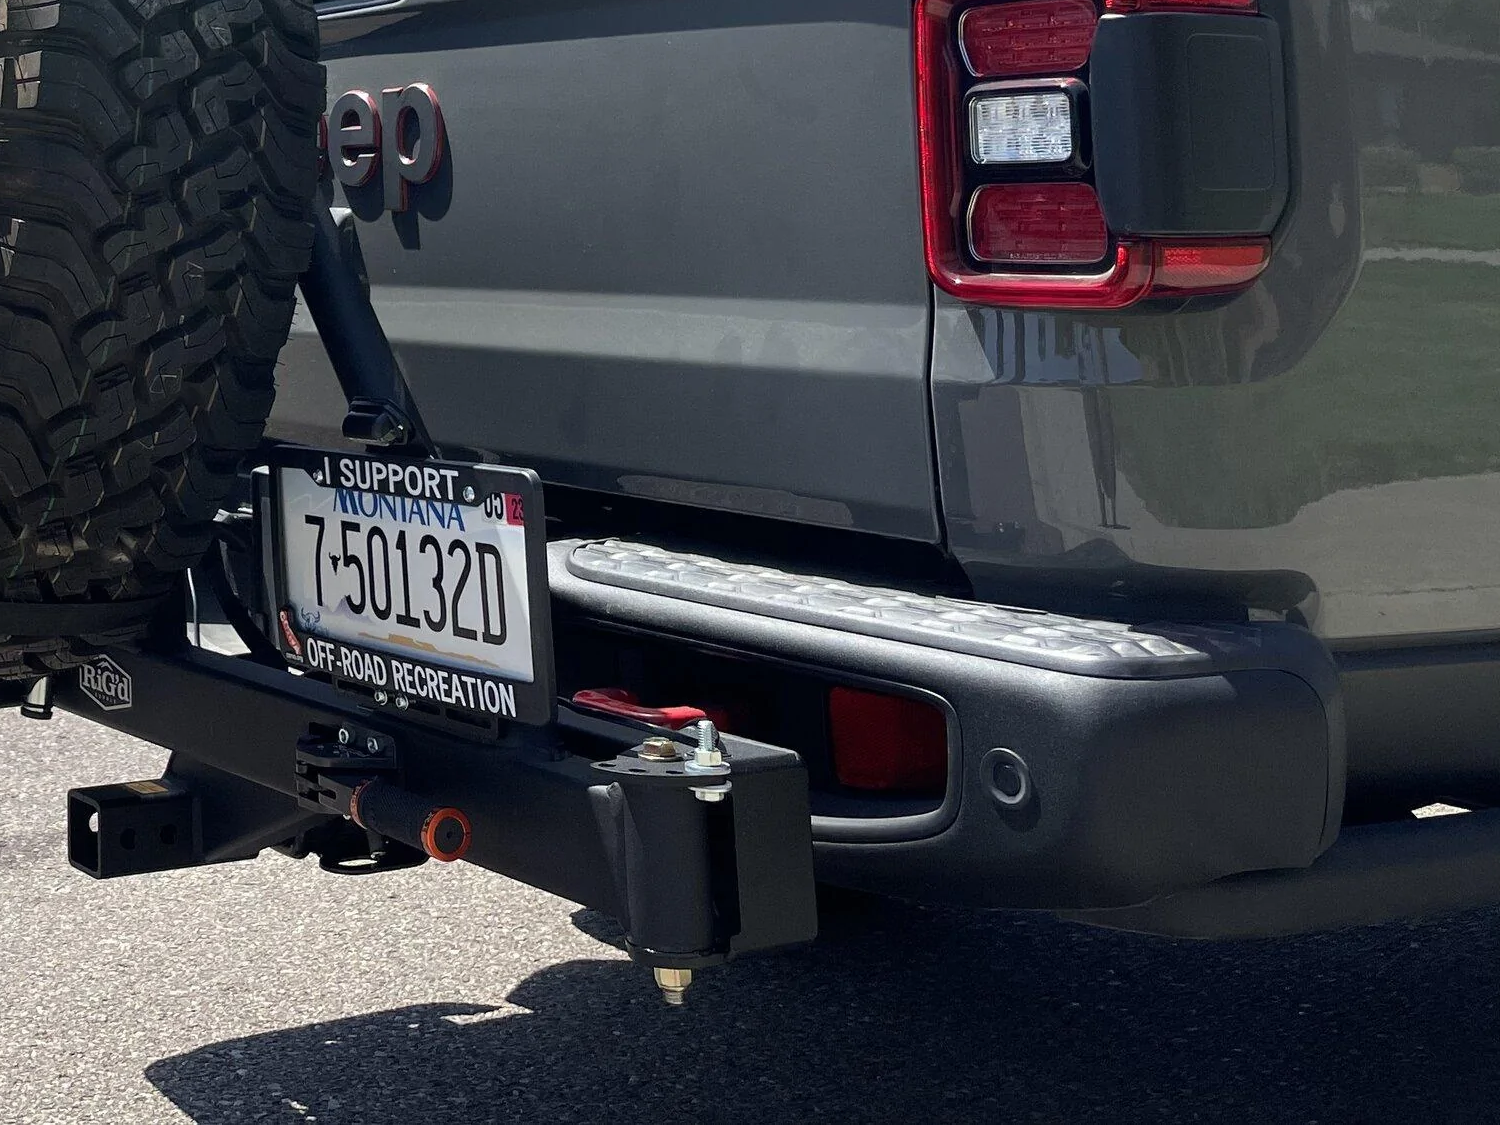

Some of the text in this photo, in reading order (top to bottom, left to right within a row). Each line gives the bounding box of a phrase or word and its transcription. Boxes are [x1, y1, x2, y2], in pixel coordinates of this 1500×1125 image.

[318, 82, 445, 213] ep
[323, 456, 459, 501] I SUPPORT
[333, 488, 466, 532] MONTANA
[306, 637, 518, 719] OFF-ROAD RECREATION
